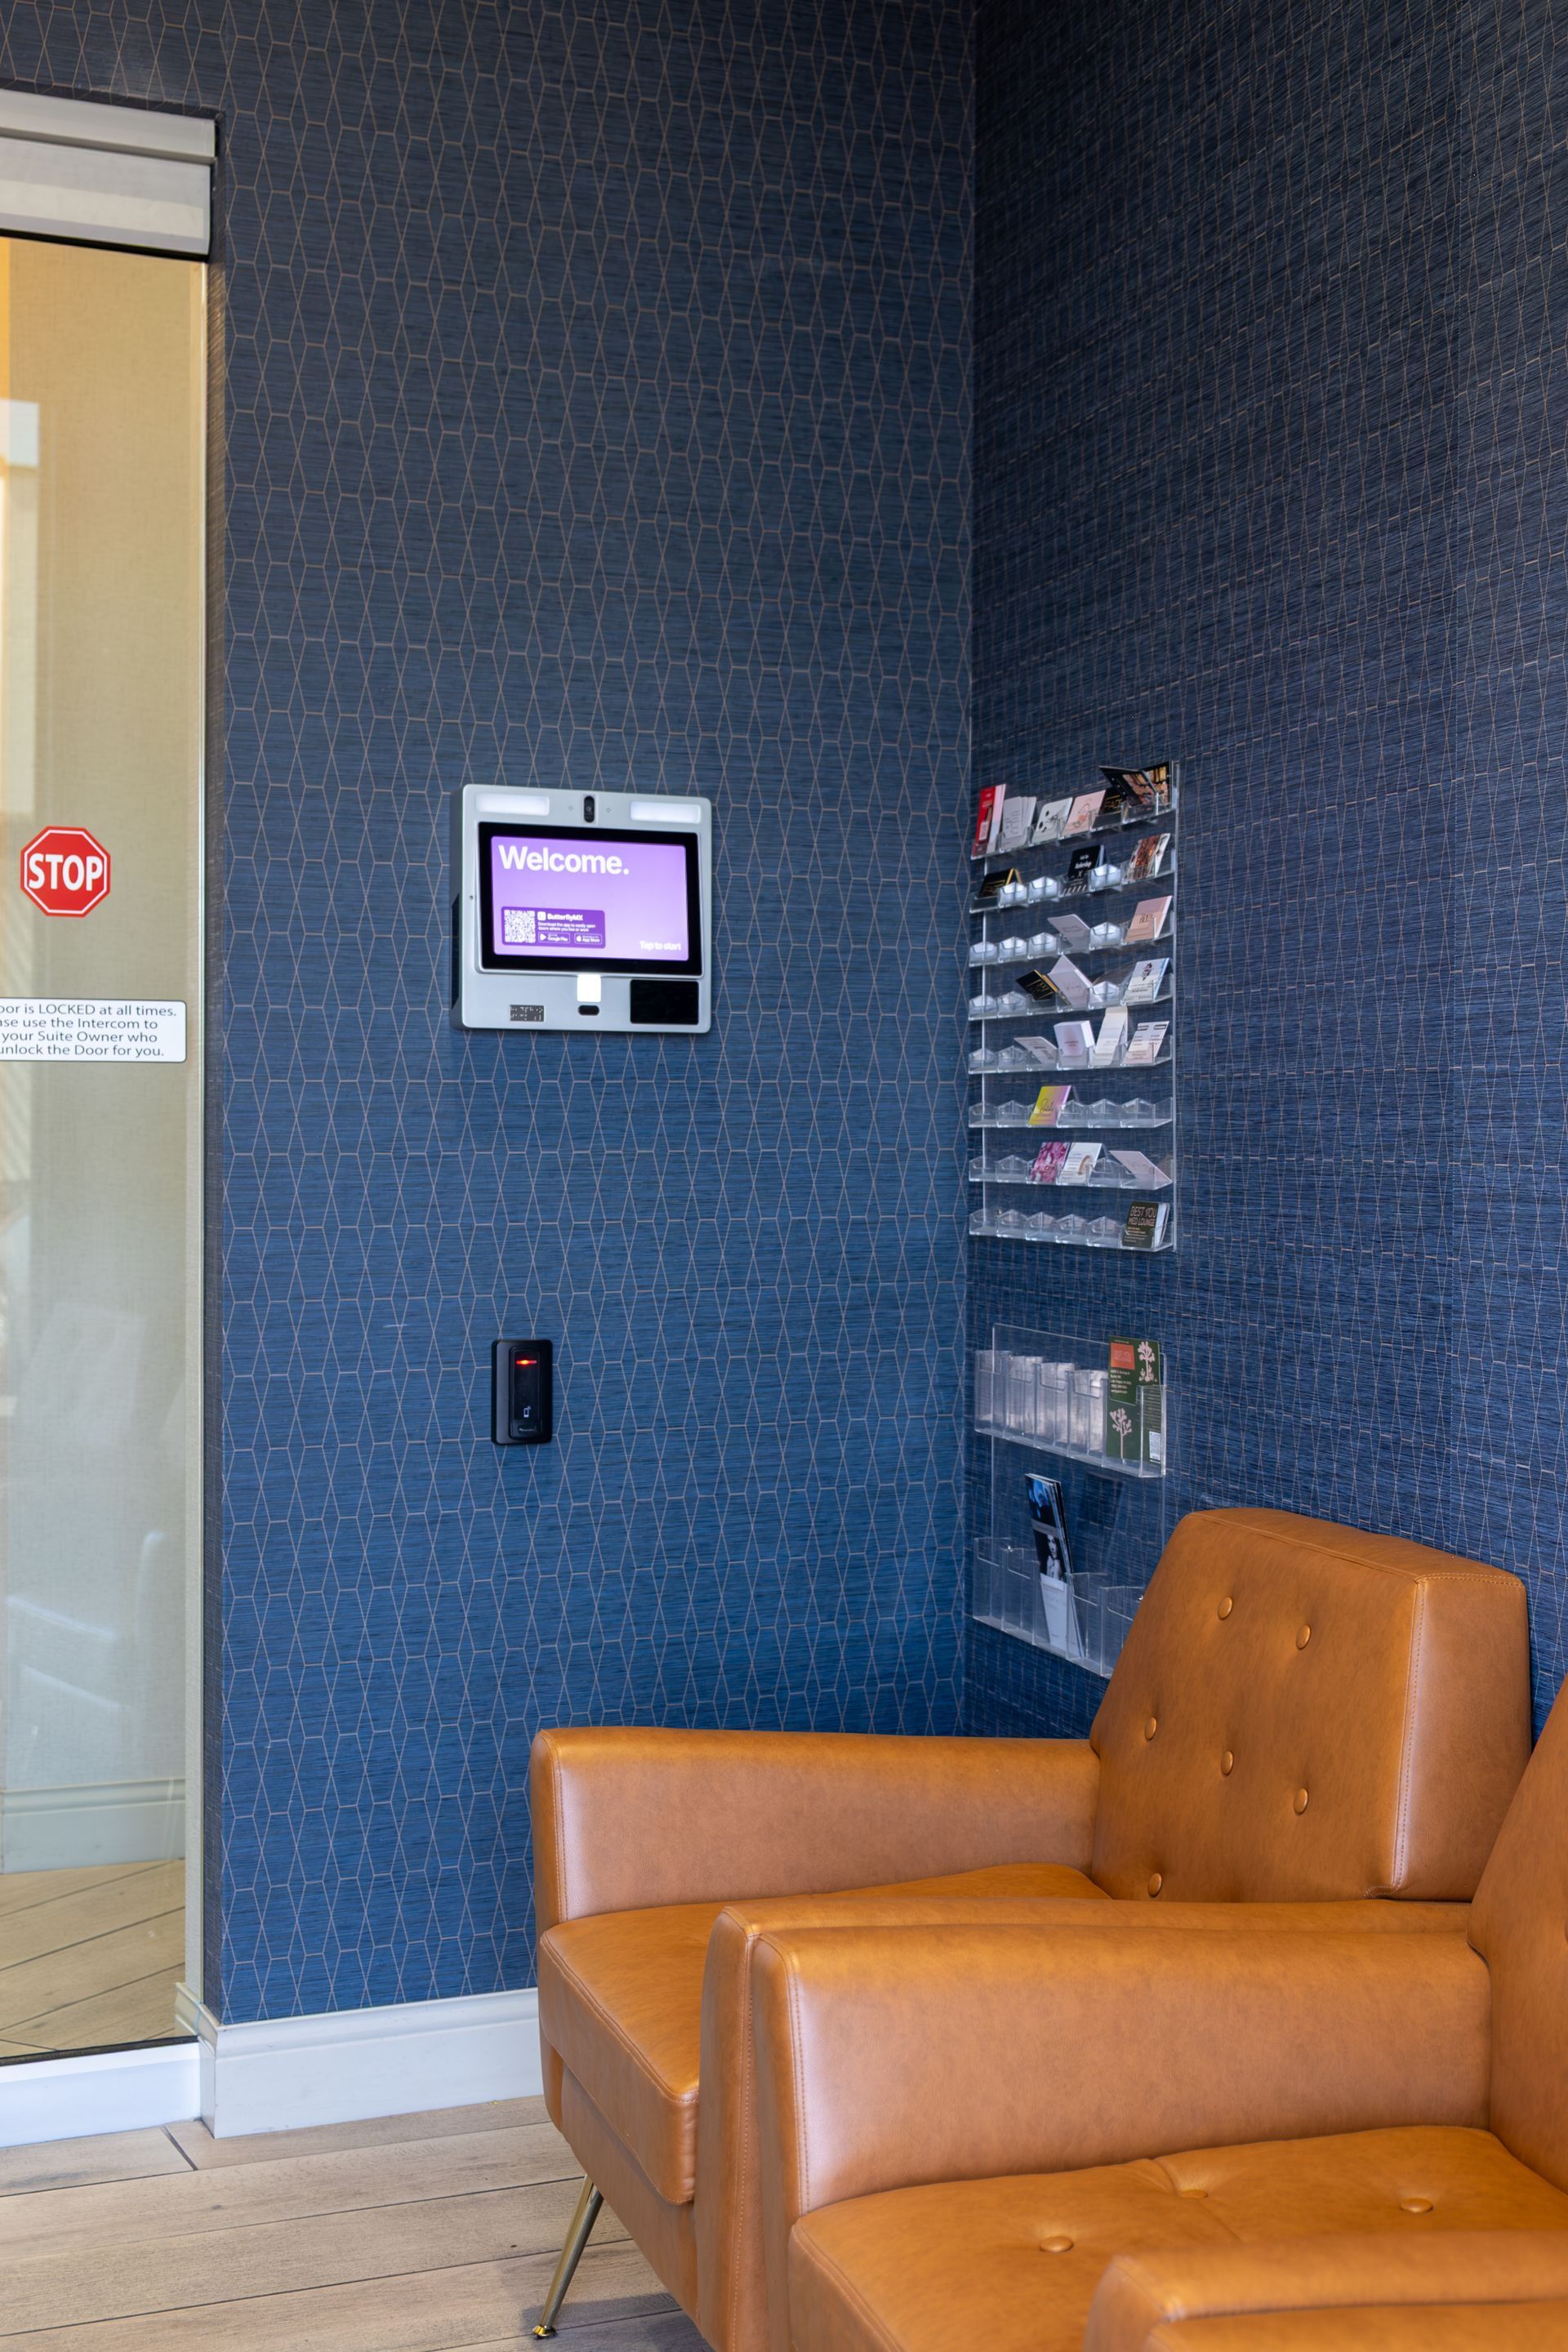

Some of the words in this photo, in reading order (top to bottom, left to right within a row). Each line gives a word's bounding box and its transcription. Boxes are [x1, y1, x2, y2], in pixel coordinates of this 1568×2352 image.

[498, 844, 629, 875] Welcome.
[29, 853, 103, 892] STOP
[639, 940, 653, 951] Tap
[654, 942, 662, 950] to
[663, 942, 681, 951] start
[24, 1004, 34, 1013] is
[38, 1004, 96, 1014] LOCKED
[99, 1006, 112, 1015] at
[116, 1004, 131, 1016] all
[136, 1005, 176, 1017] times.
[0, 1019, 18, 1027] se
[23, 1019, 47, 1027] use
[51, 1017, 74, 1027] the
[78, 1018, 140, 1029] Intercom
[144, 1019, 158, 1029] to
[2, 1032, 33, 1044] your
[38, 1031, 73, 1041] Suite
[77, 1031, 123, 1042] Owner
[127, 1032, 158, 1043] who
[47, 1044, 70, 1055] the
[74, 1045, 109, 1056] Door
[113, 1045, 131, 1056] for
[135, 1048, 164, 1058] you.
